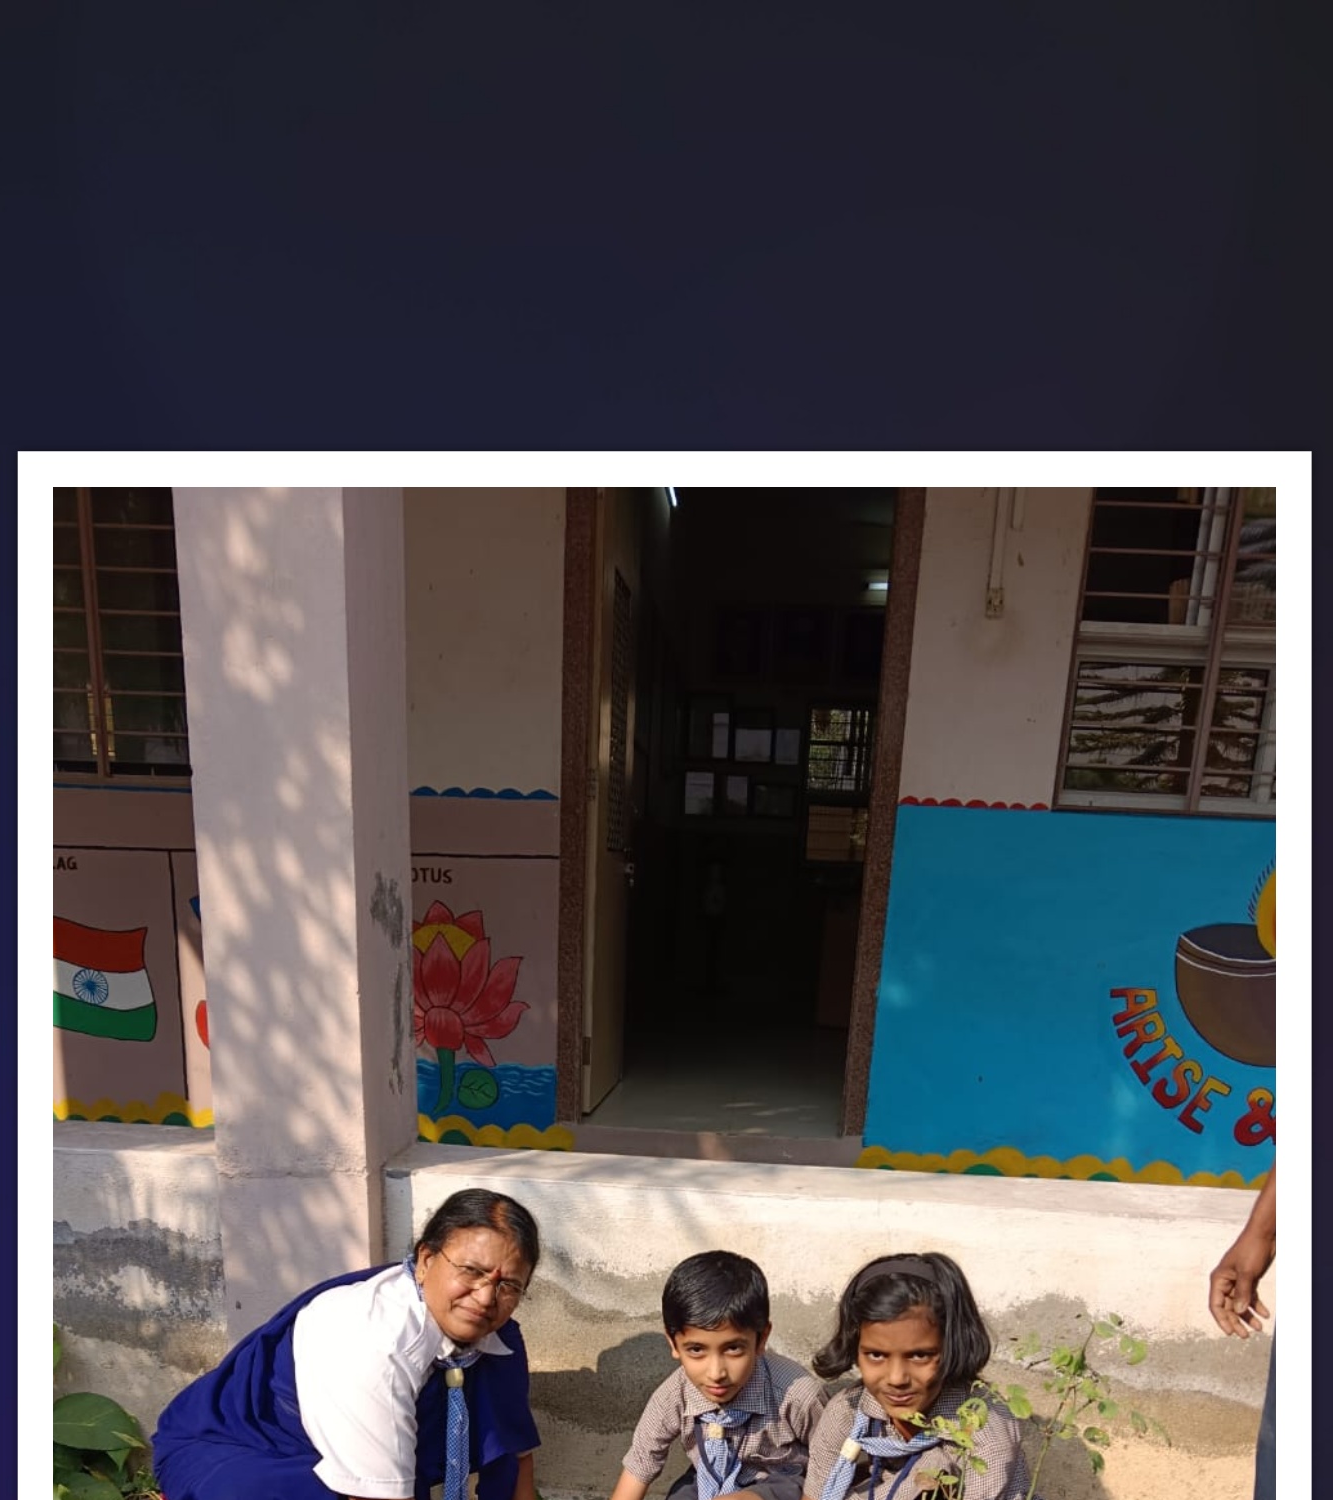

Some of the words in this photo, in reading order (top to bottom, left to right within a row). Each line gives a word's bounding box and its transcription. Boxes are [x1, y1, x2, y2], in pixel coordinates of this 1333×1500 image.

[53, 856, 78, 870] AG
[1110, 986, 1232, 1134] ARISE
[1234, 1087, 1276, 1146] &
